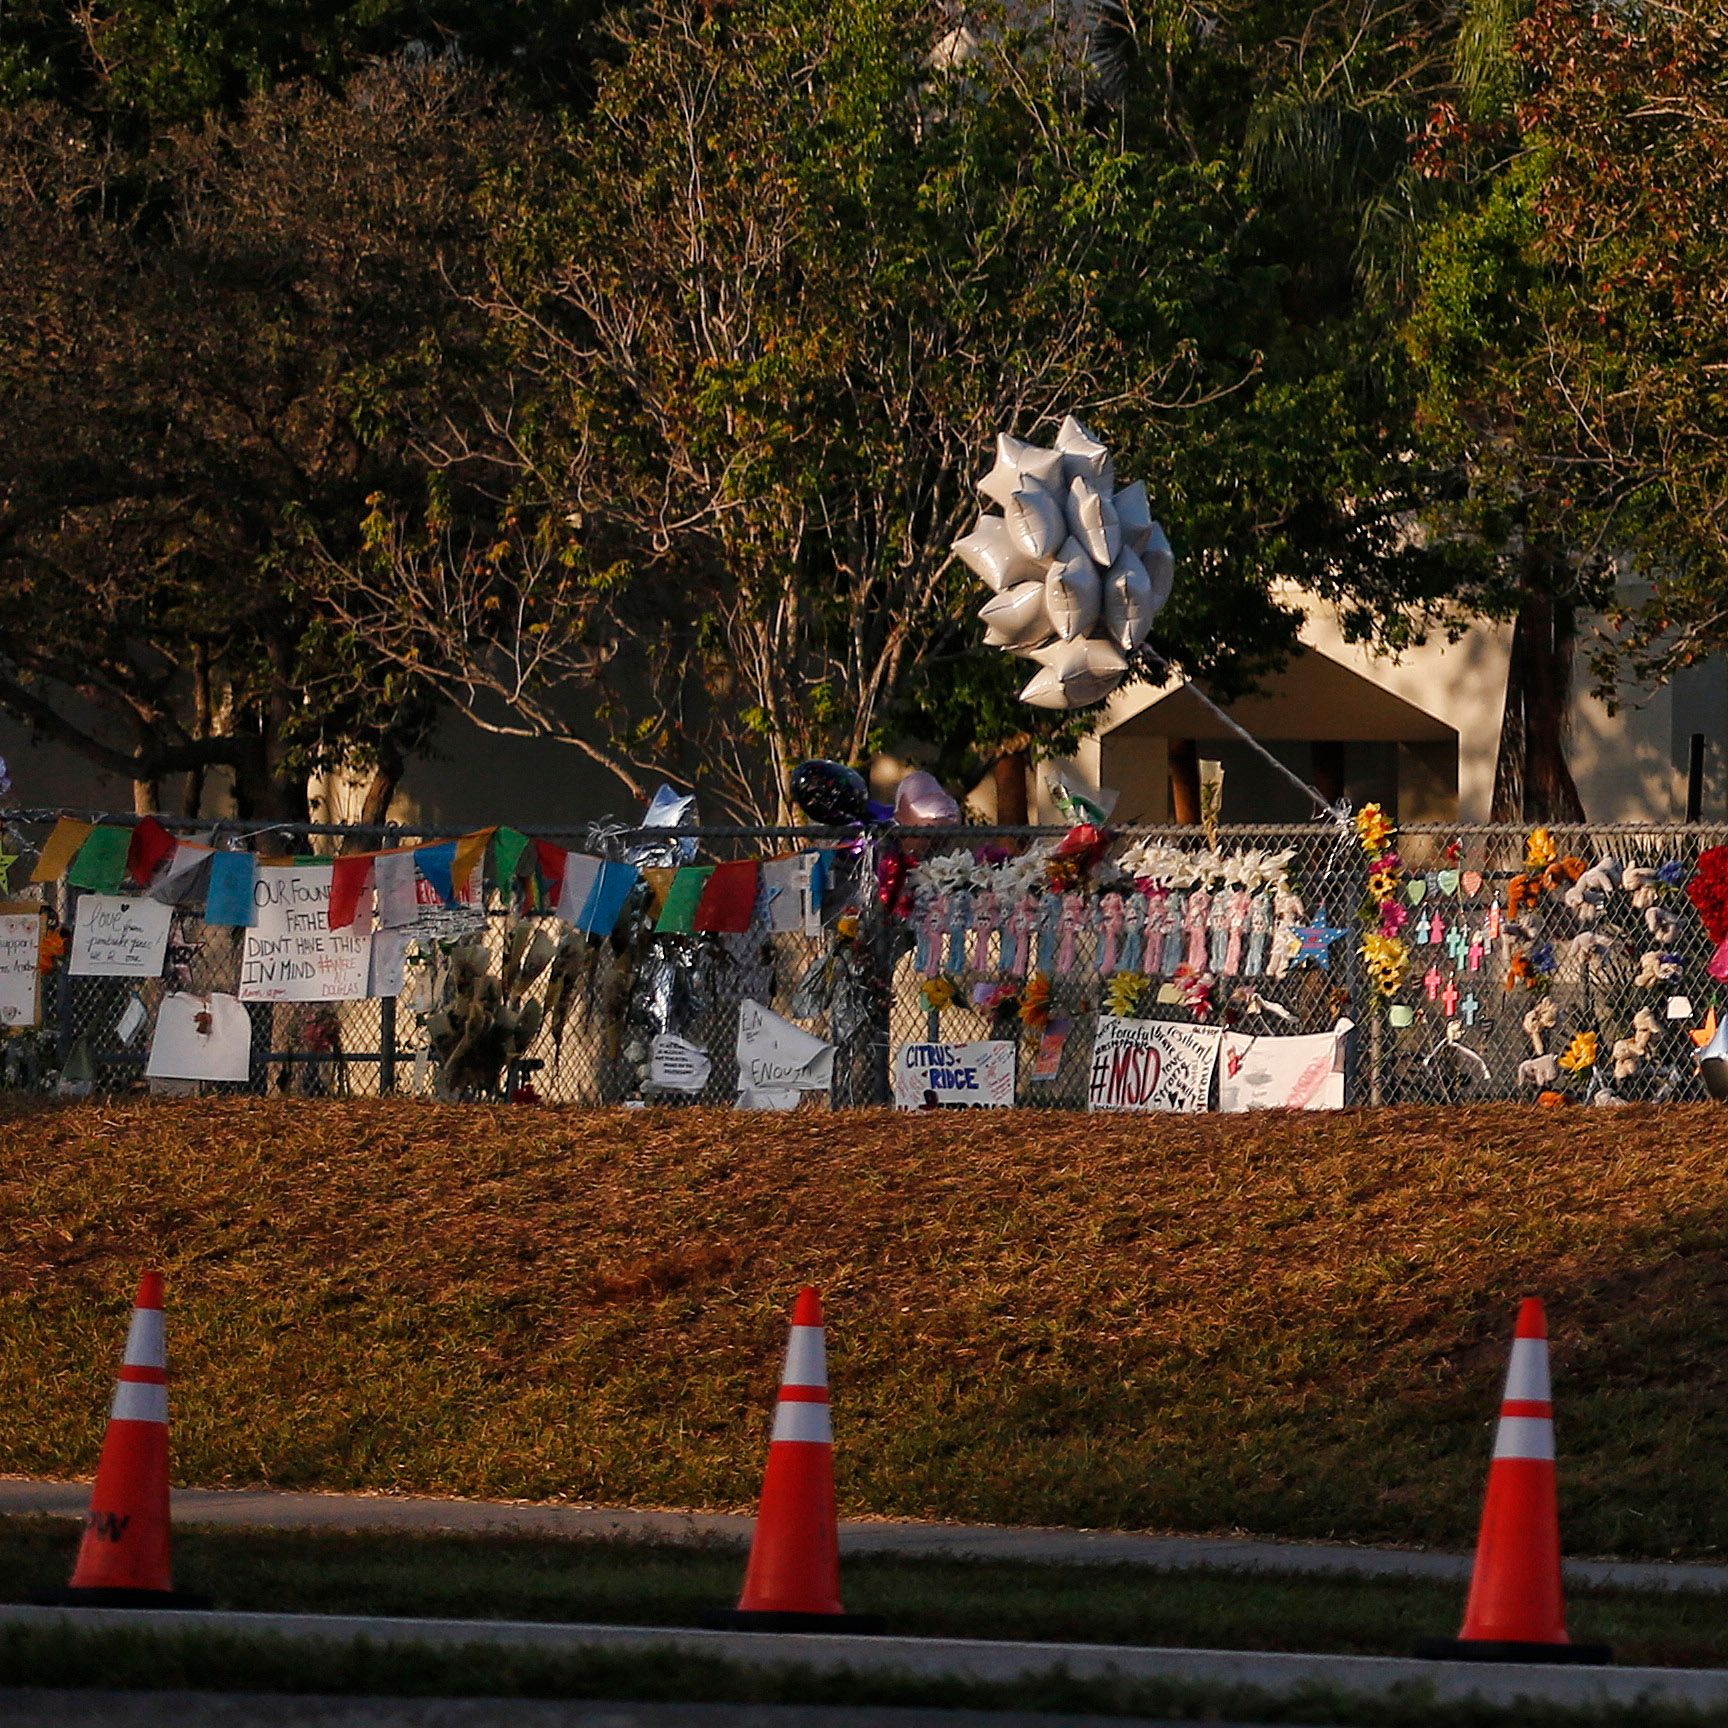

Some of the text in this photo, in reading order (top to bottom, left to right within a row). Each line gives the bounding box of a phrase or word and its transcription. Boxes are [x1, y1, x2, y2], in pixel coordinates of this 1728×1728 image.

[329, 936, 363, 954] THIS
[242, 958, 316, 985] IN MIND
[906, 1044, 957, 1069] CITRUS
[1090, 1045, 1162, 1106] #MSD
